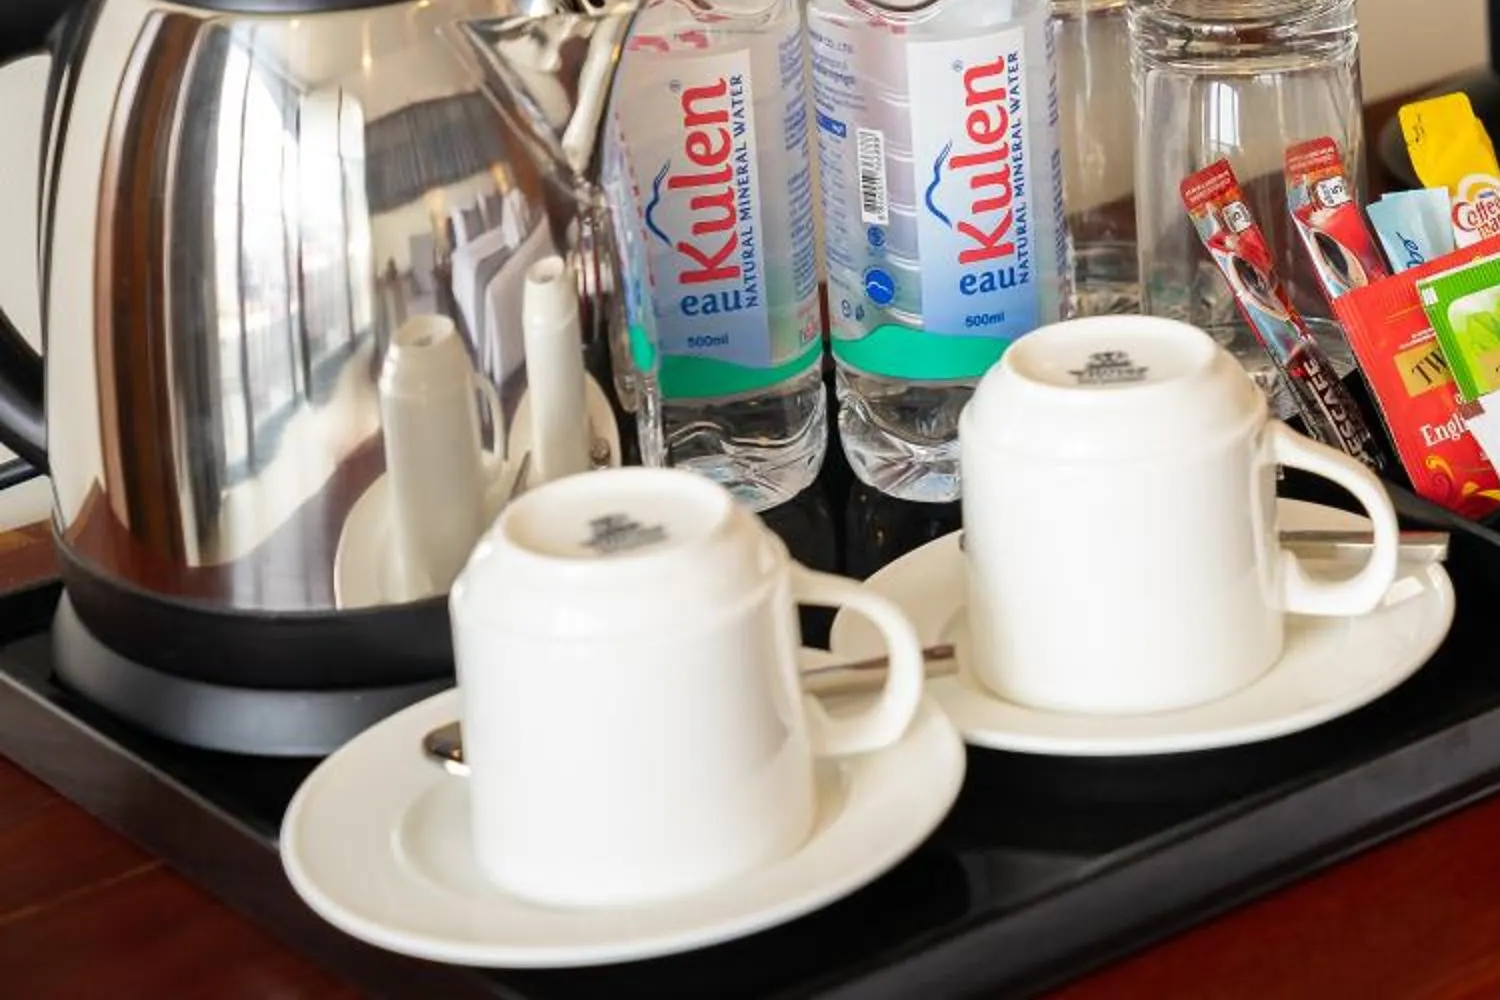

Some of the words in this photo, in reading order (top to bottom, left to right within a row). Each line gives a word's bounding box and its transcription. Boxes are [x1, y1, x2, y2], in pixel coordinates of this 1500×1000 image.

[729, 74, 746, 138] WATER
[1007, 51, 1020, 114] WATER
[667, 77, 741, 285] Kulen
[736, 142, 751, 218] MINERAL
[948, 55, 1015, 264] Kulen
[1011, 117, 1026, 197] MINERAL
[739, 226, 758, 308] NATURAL
[1016, 201, 1029, 284] NATURAL
[680, 288, 742, 316] eau
[959, 266, 1017, 296] eau
[687, 332, 729, 348] 500ml
[965, 312, 1005, 328] 500ml
[1419, 412, 1467, 447] Engl
